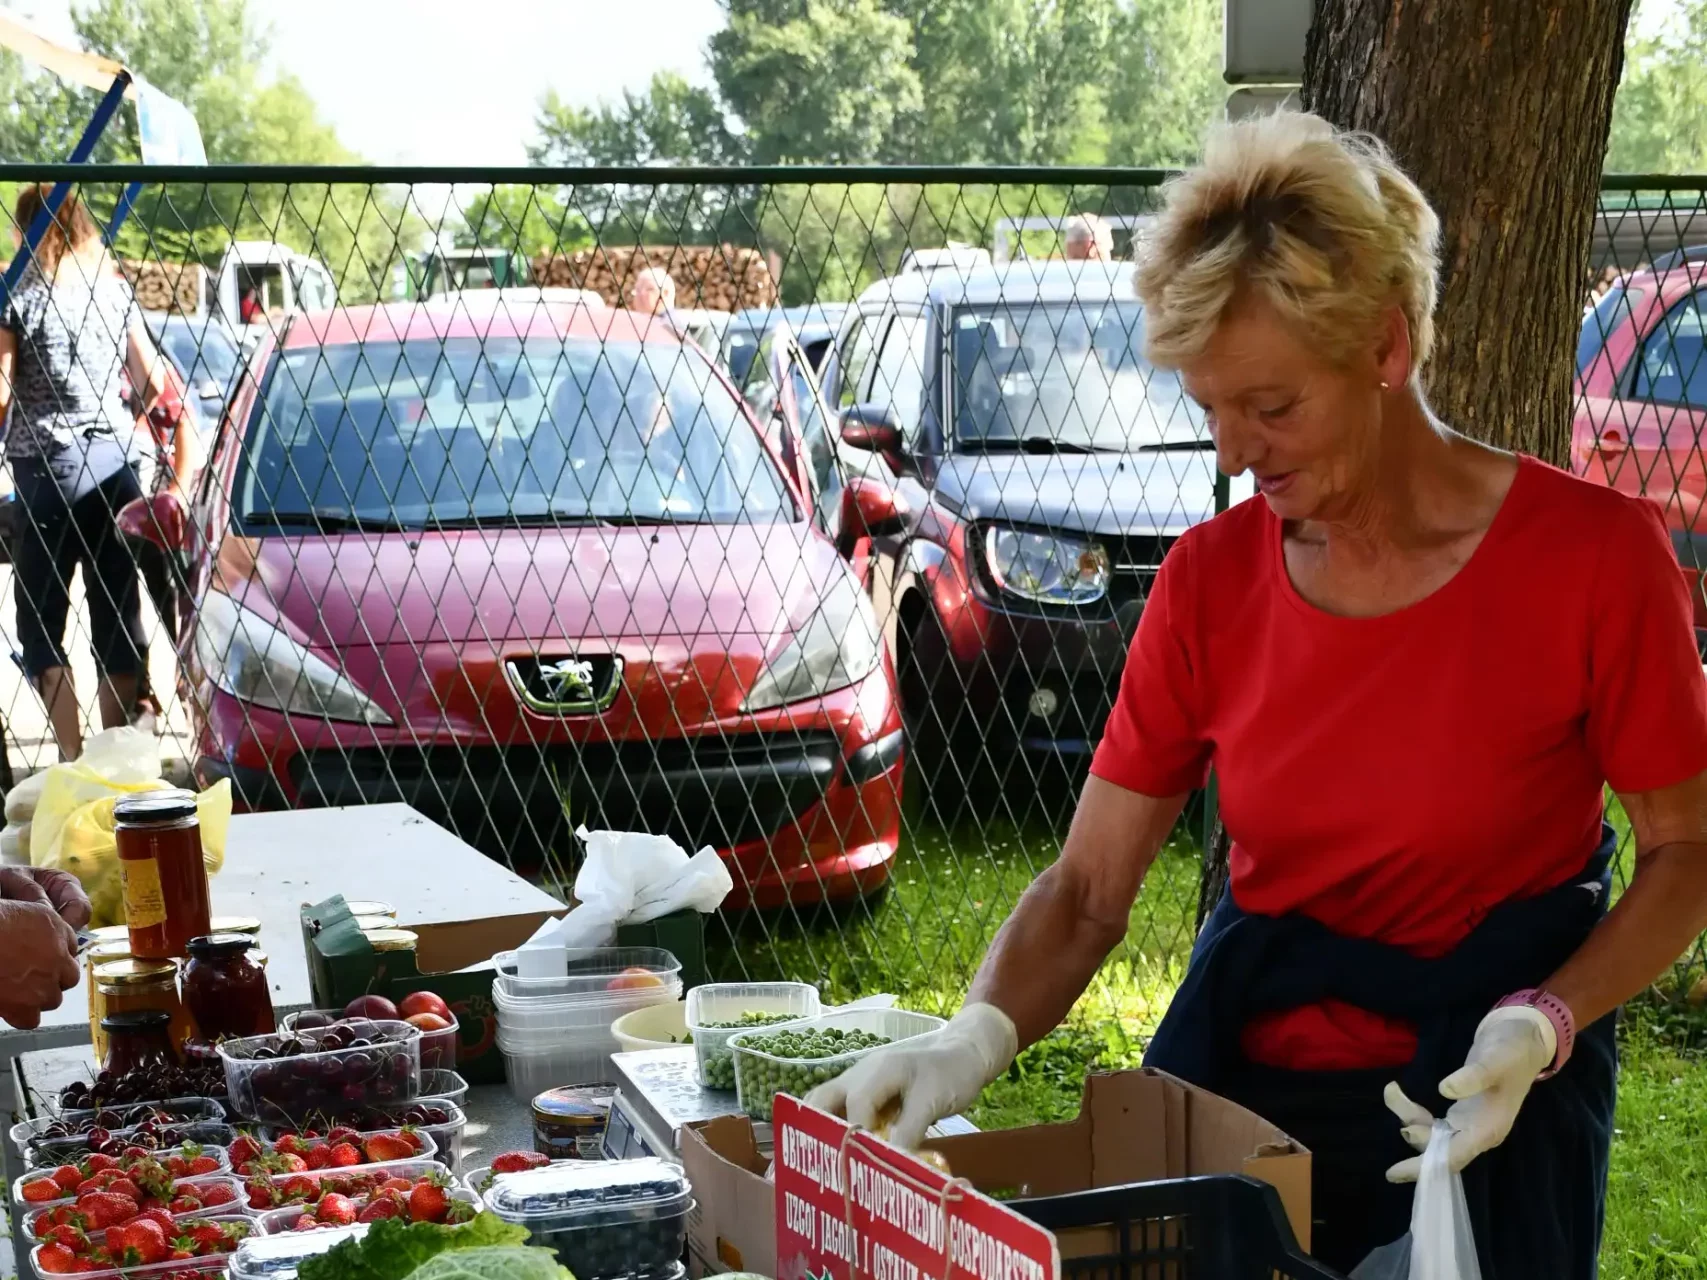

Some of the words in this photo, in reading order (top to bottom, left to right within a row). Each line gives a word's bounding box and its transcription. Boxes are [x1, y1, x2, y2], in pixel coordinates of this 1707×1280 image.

[782, 1123, 846, 1196] OBITELJSKO
[850, 1156, 944, 1255] POLJOPRIVREDNO
[785, 1191, 816, 1250] UZGOJ
[863, 1235, 869, 1274] I
